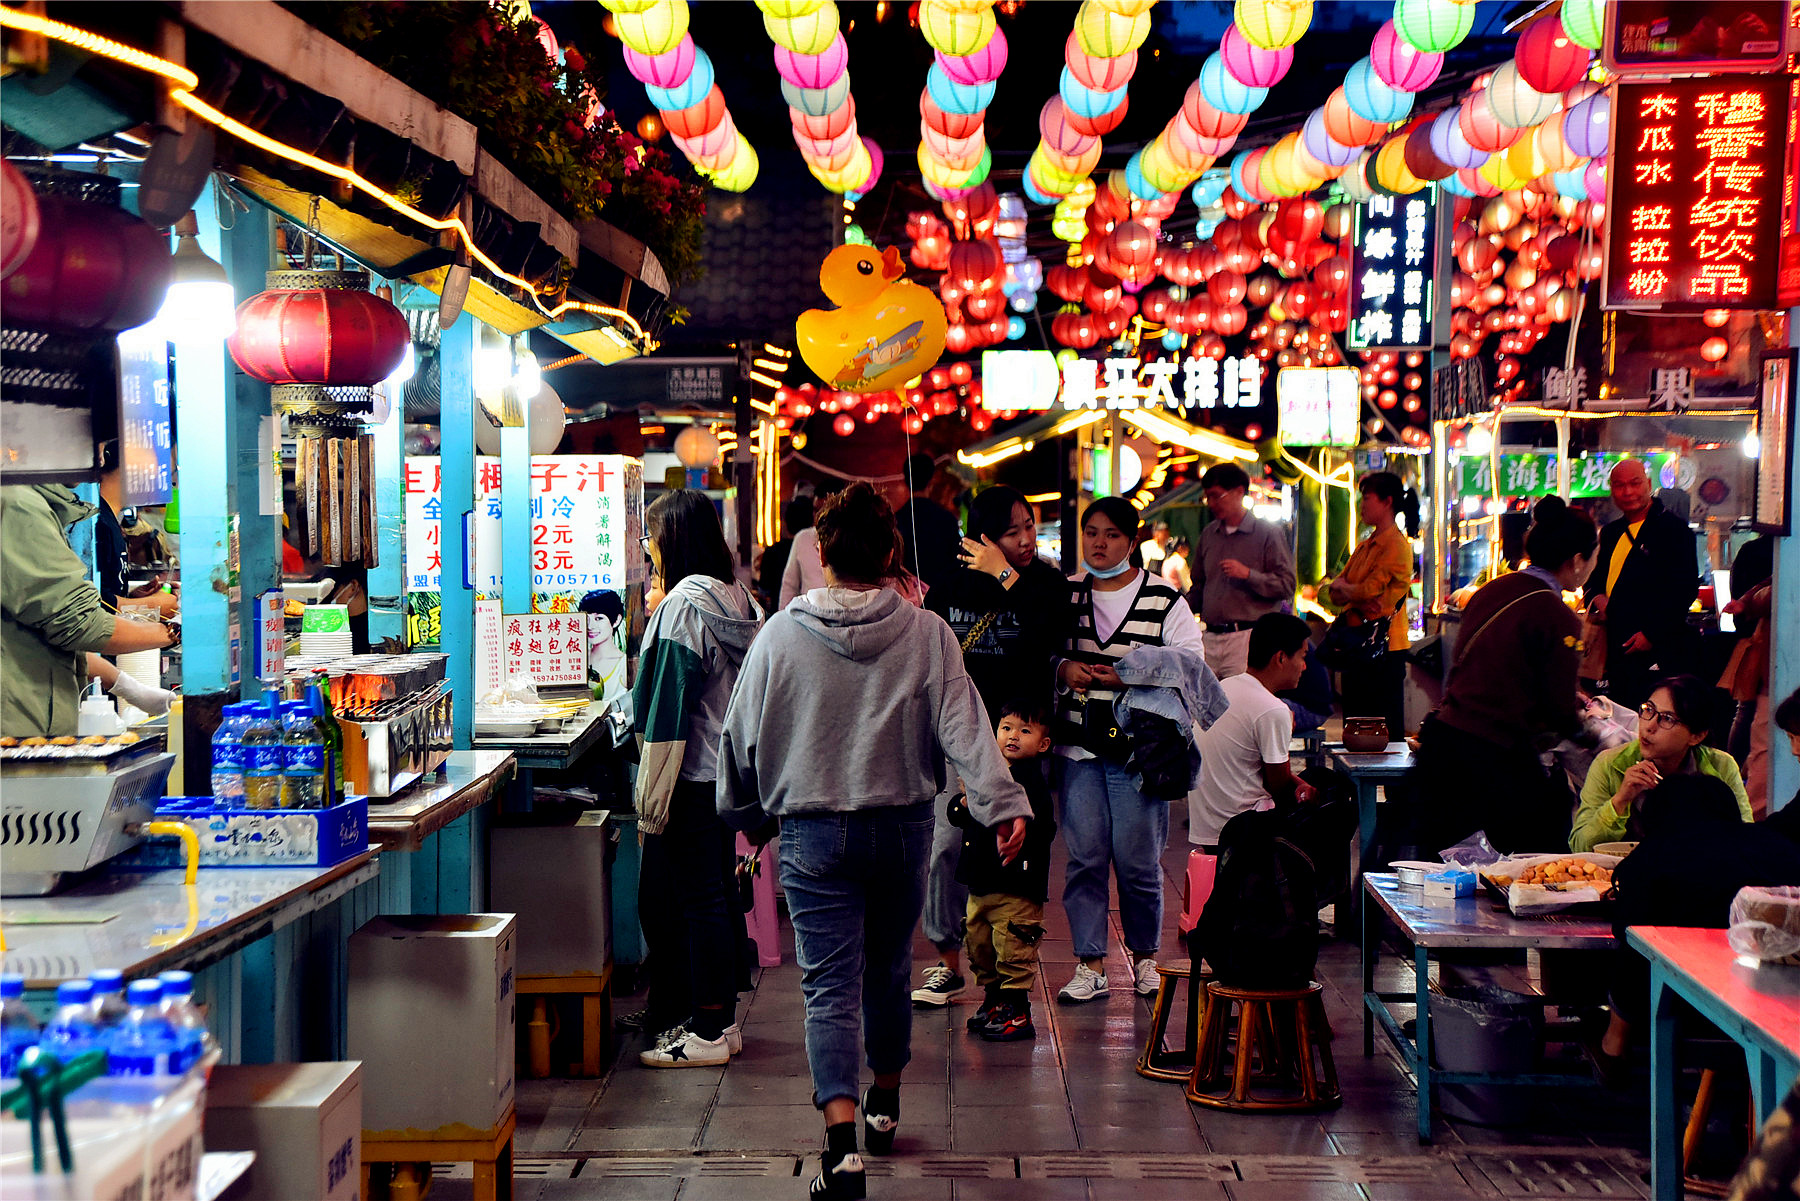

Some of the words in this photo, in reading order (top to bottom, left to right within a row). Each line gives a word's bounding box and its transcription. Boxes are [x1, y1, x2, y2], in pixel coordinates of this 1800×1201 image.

[1636, 93, 1678, 185] 木瓜水
[1629, 205, 1671, 295] 拉拉粉
[405, 462, 614, 494] 生椰子汁
[533, 525, 573, 545] 2元
[534, 550, 573, 570] 3元
[507, 618, 583, 636] 疯狂烤翅
[508, 637, 583, 657] 鸡翅包饭
